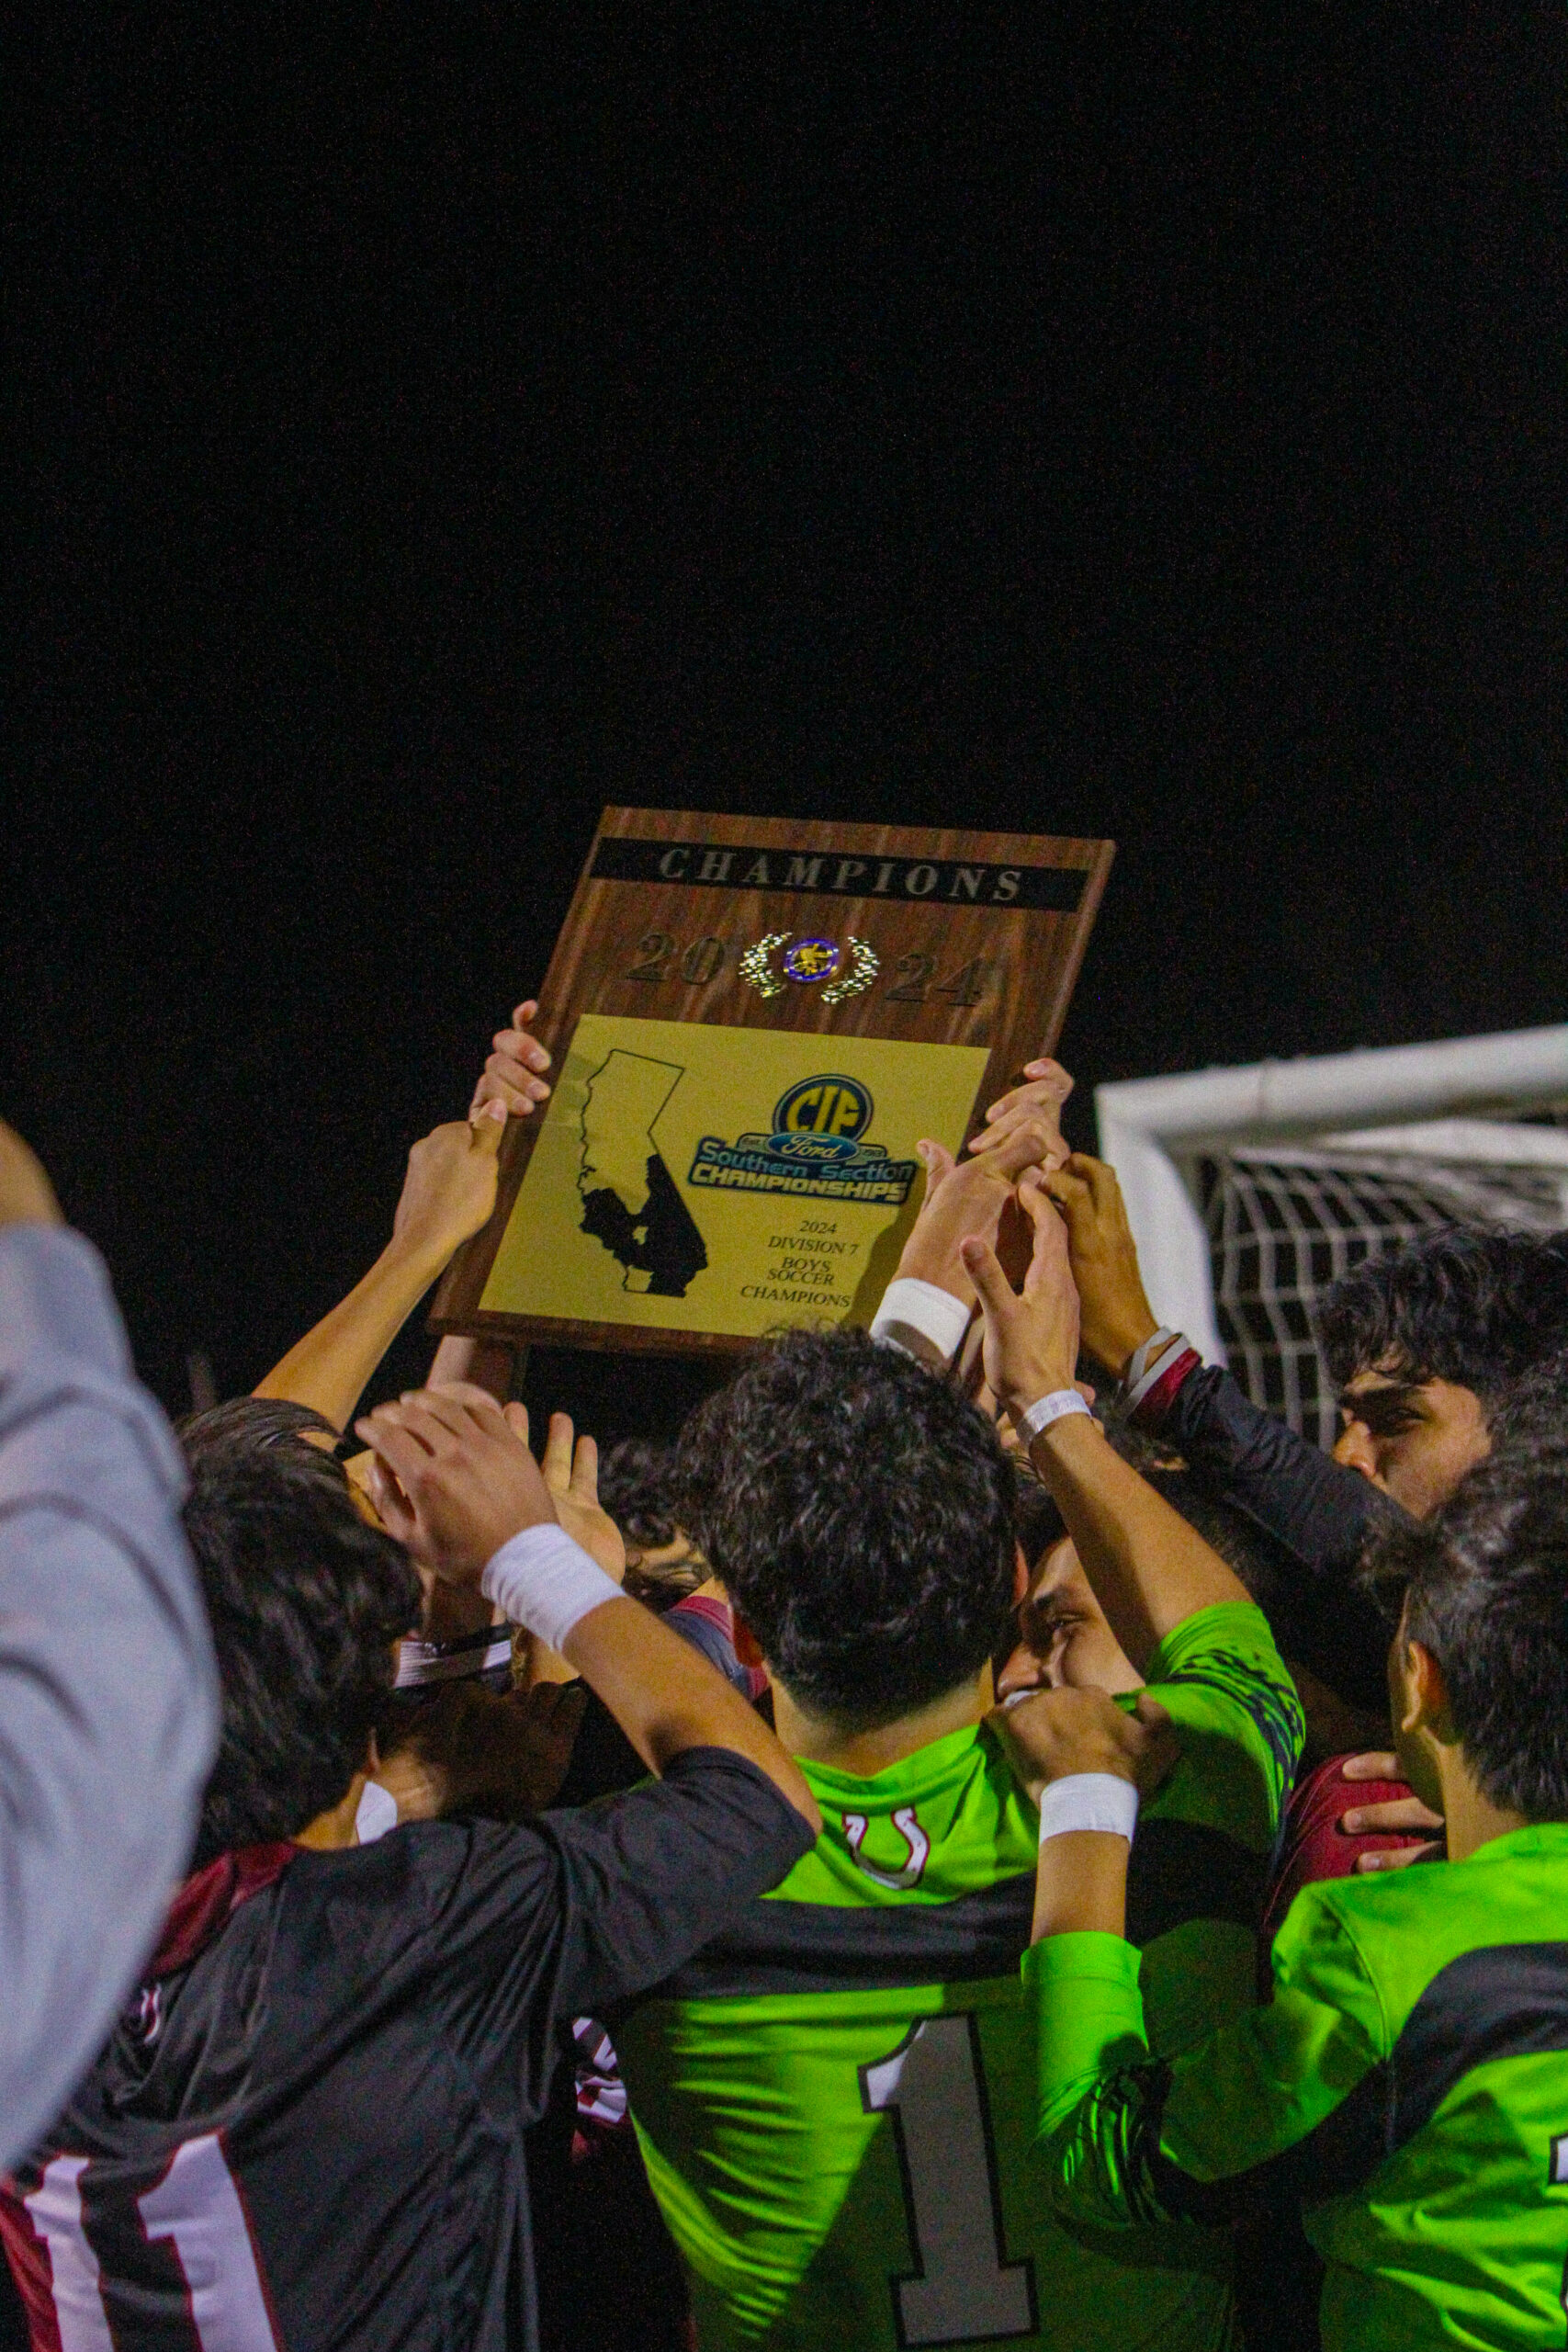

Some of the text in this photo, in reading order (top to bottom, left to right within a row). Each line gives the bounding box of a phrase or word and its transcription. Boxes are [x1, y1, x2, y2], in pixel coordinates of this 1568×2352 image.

[659, 847, 1022, 901] CHAMPIONS
[626, 933, 727, 986] 20
[786, 1084, 860, 1136] CIF
[699, 1140, 914, 1182] Southern Section
[781, 1135, 843, 1159] Ford
[691, 1161, 908, 1203] CHAMPIONSHIPS
[768, 1235, 860, 1256] DIVISION 7
[799, 1220, 838, 1235] 2024
[767, 1268, 835, 1286] SOCCER
[782, 1256, 832, 1272] BOYS
[739, 1284, 852, 1308] CHAMPIONS
[857, 2012, 1041, 2350] 1
[22, 2128, 278, 2352] 11
